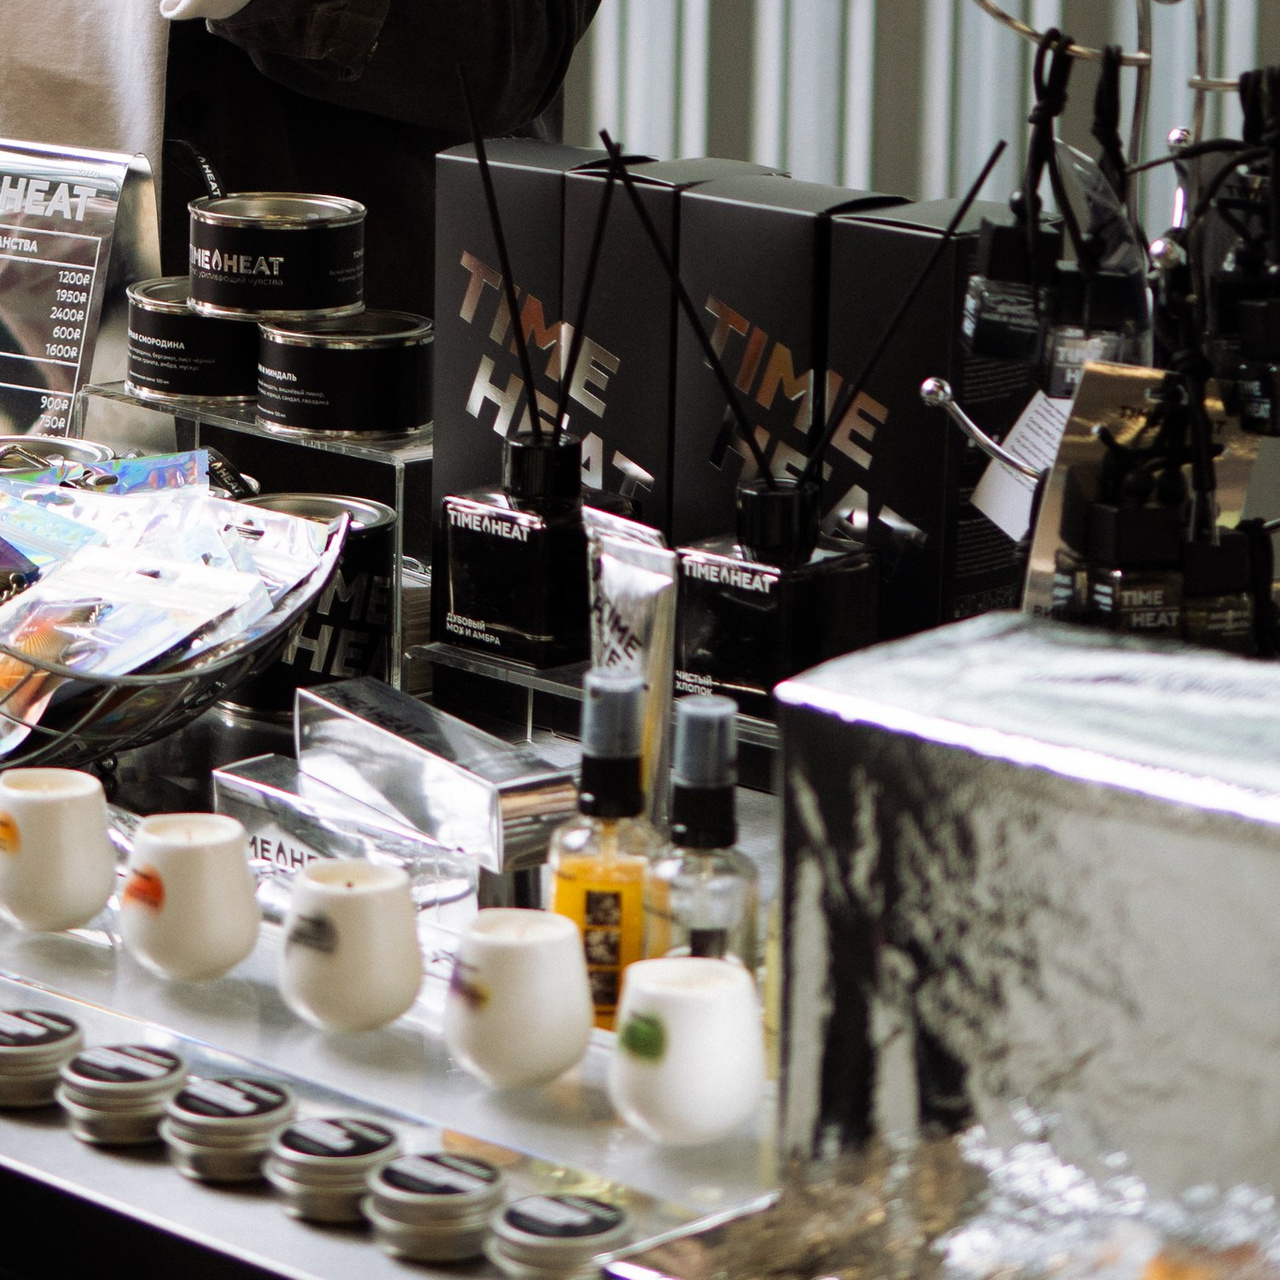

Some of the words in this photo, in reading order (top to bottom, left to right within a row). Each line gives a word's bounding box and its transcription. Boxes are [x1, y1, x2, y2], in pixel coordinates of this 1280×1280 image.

[446, 612, 486, 631] ДУБОВЫЙ
[446, 622, 464, 635] МОХ
[465, 627, 471, 637] И
[472, 630, 501, 646] АМБРА
[676, 670, 712, 687] ЧИСТЫЙ
